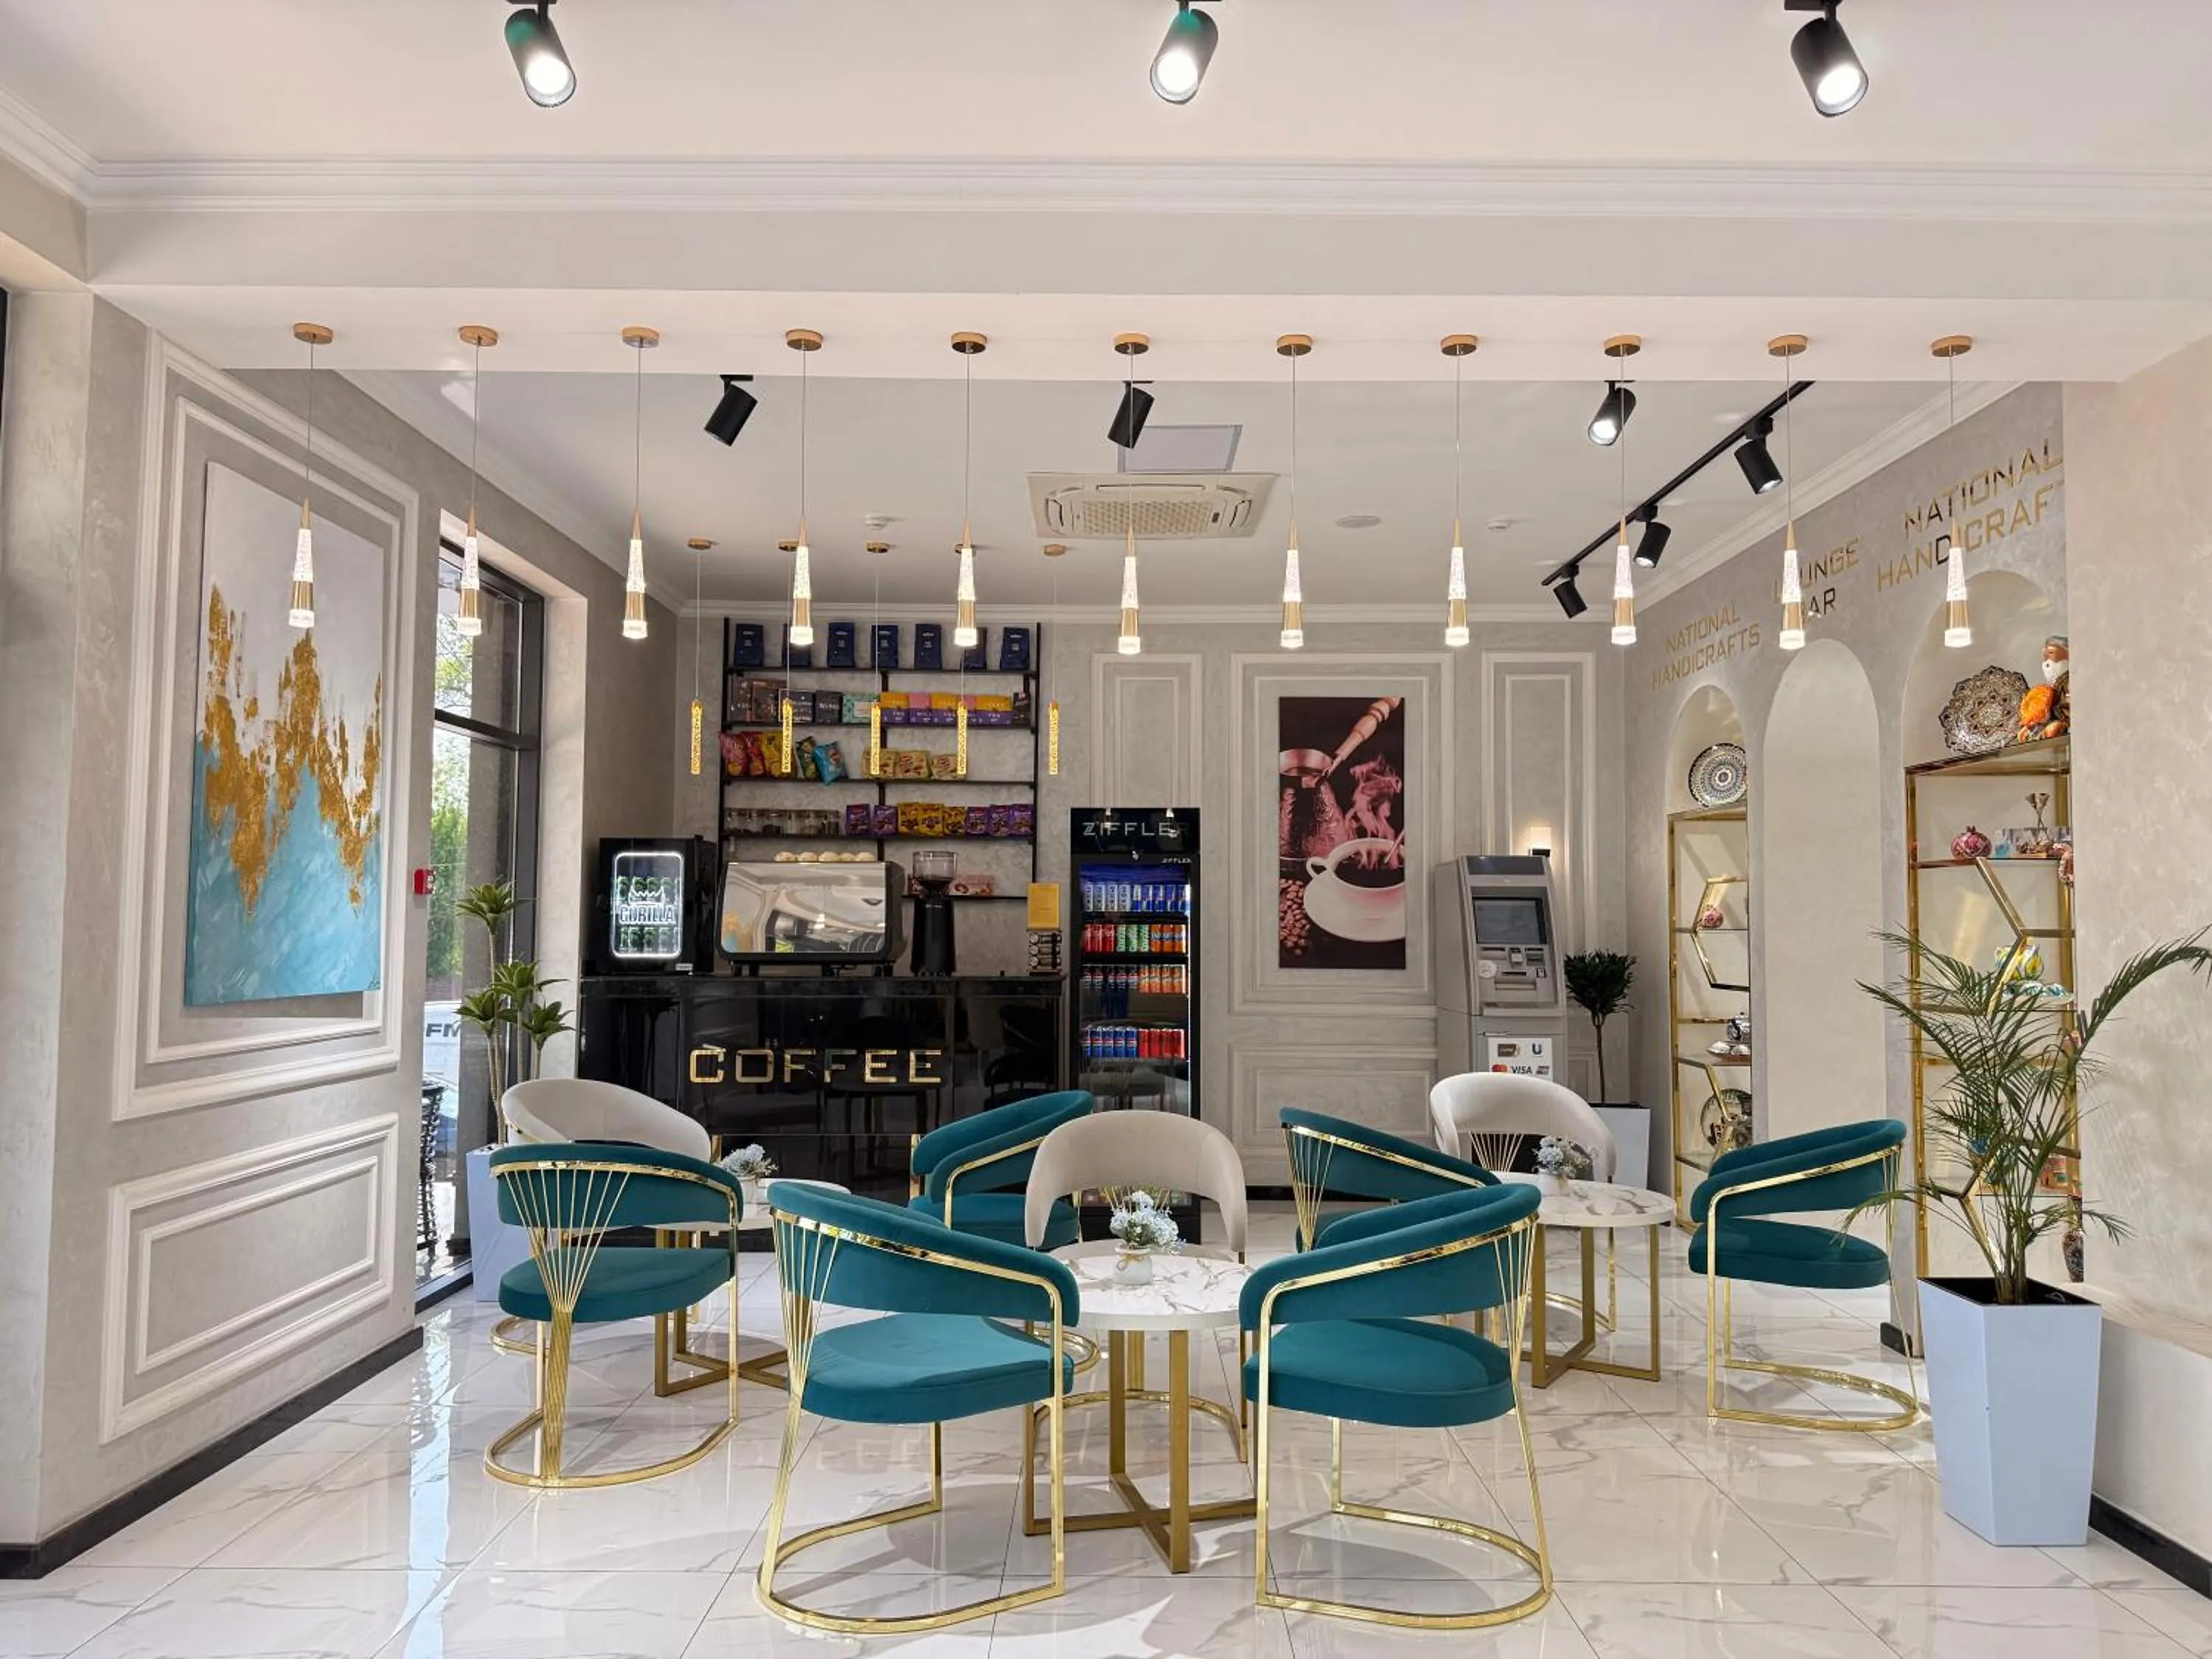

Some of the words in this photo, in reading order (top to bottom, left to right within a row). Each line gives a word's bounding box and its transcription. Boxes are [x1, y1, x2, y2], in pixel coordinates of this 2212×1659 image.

[1903, 437, 2063, 540] NATIONAL
[1774, 535, 1860, 604] LUNGE
[1652, 622, 1761, 691] HANDICRAFTS
[1666, 600, 1742, 654] NATIONAL
[689, 1048, 942, 1083] COFFEE
[1510, 1065, 1533, 1074] VISA
